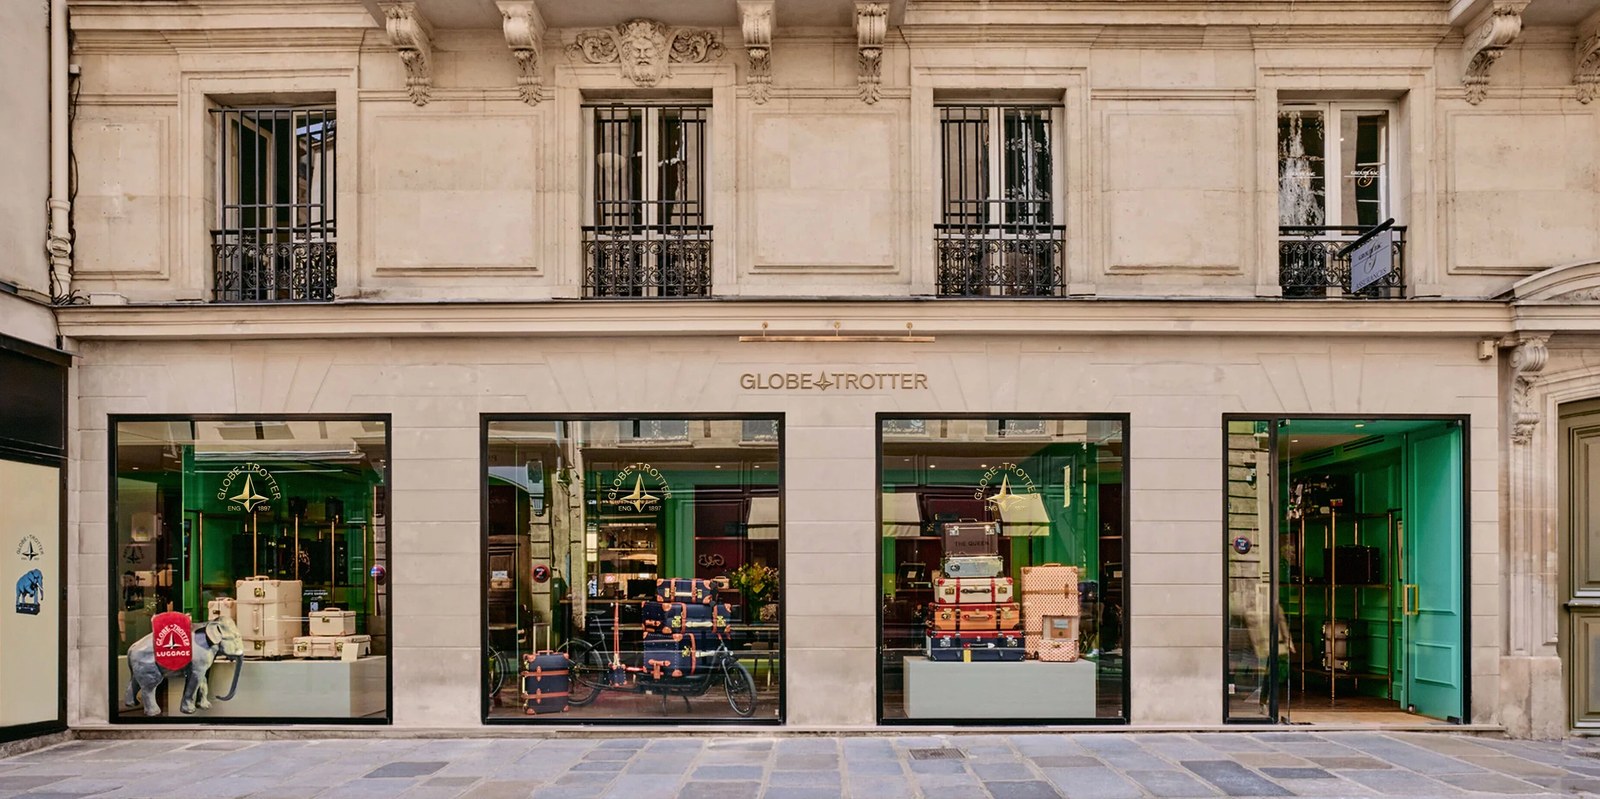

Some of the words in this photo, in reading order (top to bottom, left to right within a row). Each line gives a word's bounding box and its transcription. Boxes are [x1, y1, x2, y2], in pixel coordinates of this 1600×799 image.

[740, 373, 813, 390] GLOBE
[831, 373, 929, 390] TROTTER
[217, 466, 242, 500] GLOBE
[246, 462, 281, 500] TROTTER
[608, 466, 632, 500] GLOBE
[636, 462, 672, 500] TROTTER
[974, 466, 999, 500] GLOBE
[156, 625, 171, 646] GLOBE
[172, 623, 190, 646] TROTTER
